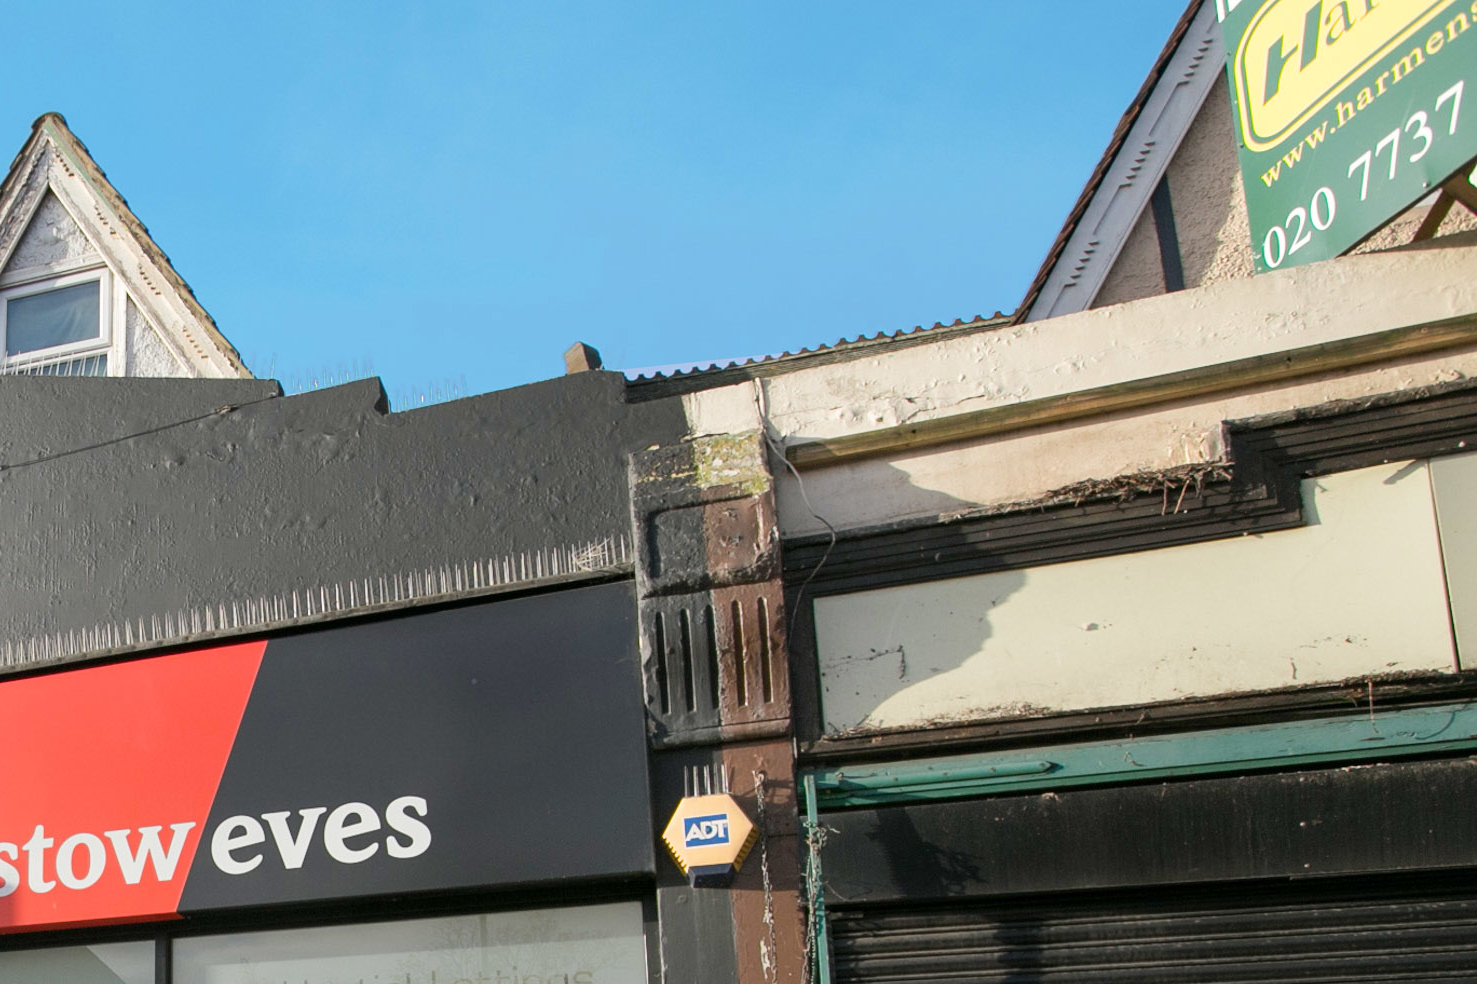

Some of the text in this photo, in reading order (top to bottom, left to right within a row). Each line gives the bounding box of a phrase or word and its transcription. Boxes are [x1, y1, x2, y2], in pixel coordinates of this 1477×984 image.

[1262, 80, 1464, 269] 020 7737
[210, 796, 432, 875] eves
[686, 819, 728, 842] ADT
